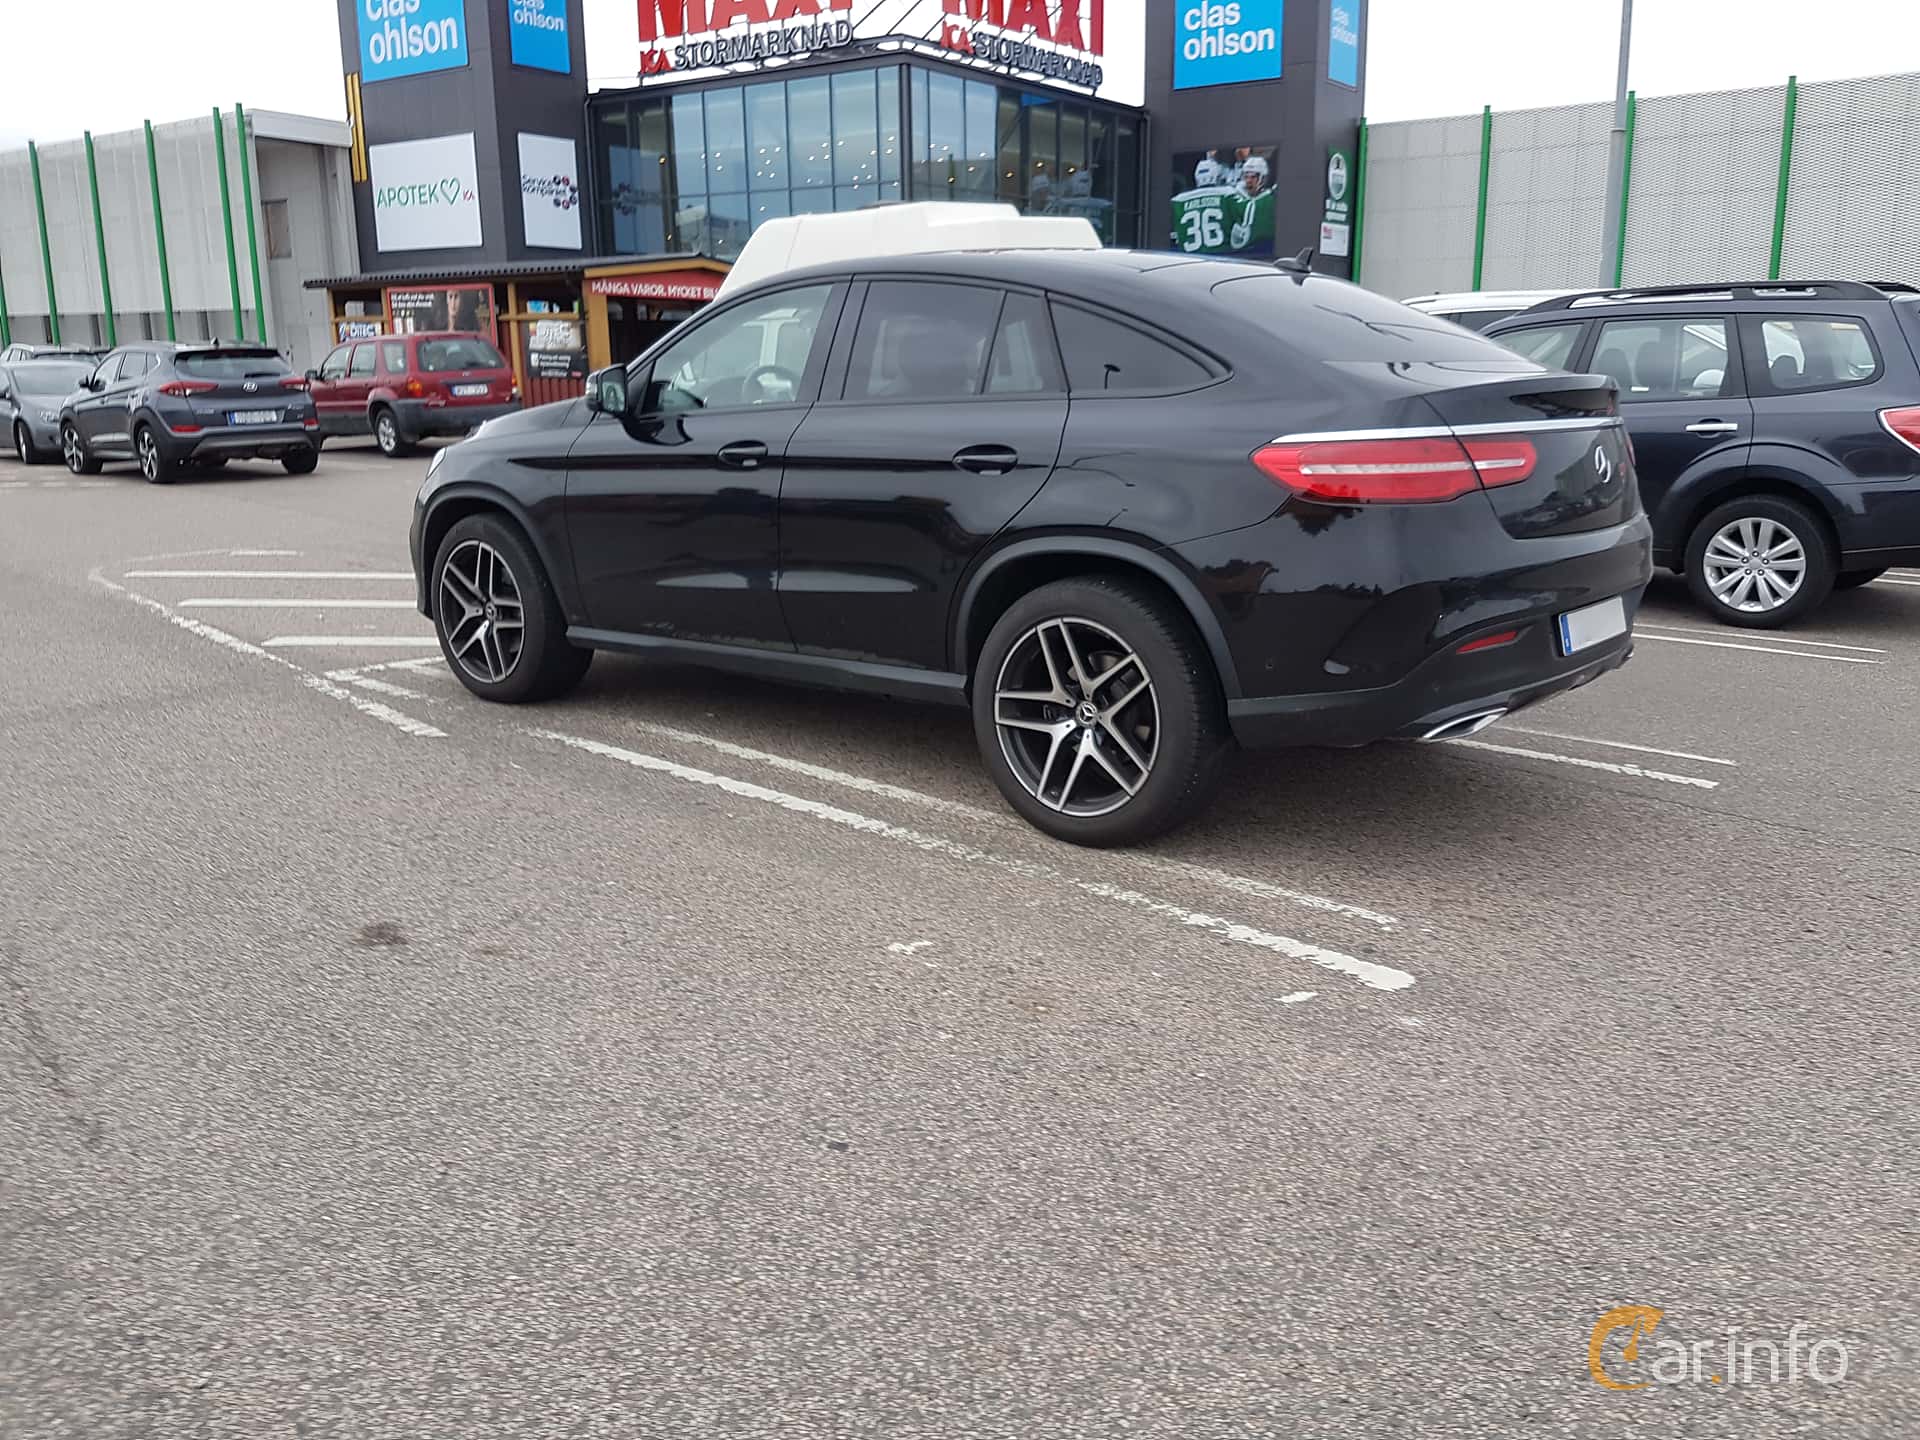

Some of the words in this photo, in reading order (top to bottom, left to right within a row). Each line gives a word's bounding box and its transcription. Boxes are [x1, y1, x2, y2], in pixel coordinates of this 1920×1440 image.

[514, 6, 564, 32] ohlson
[1184, 0, 1241, 31] clas
[369, 16, 458, 64] ohlson
[674, 20, 853, 71] STORMARKNAD
[1184, 27, 1275, 60] ohlson
[972, 31, 1103, 86] STORMARKNAD
[377, 182, 440, 208] APOTEK
[1180, 208, 1224, 252] 36
[592, 279, 630, 295] MÅNGA
